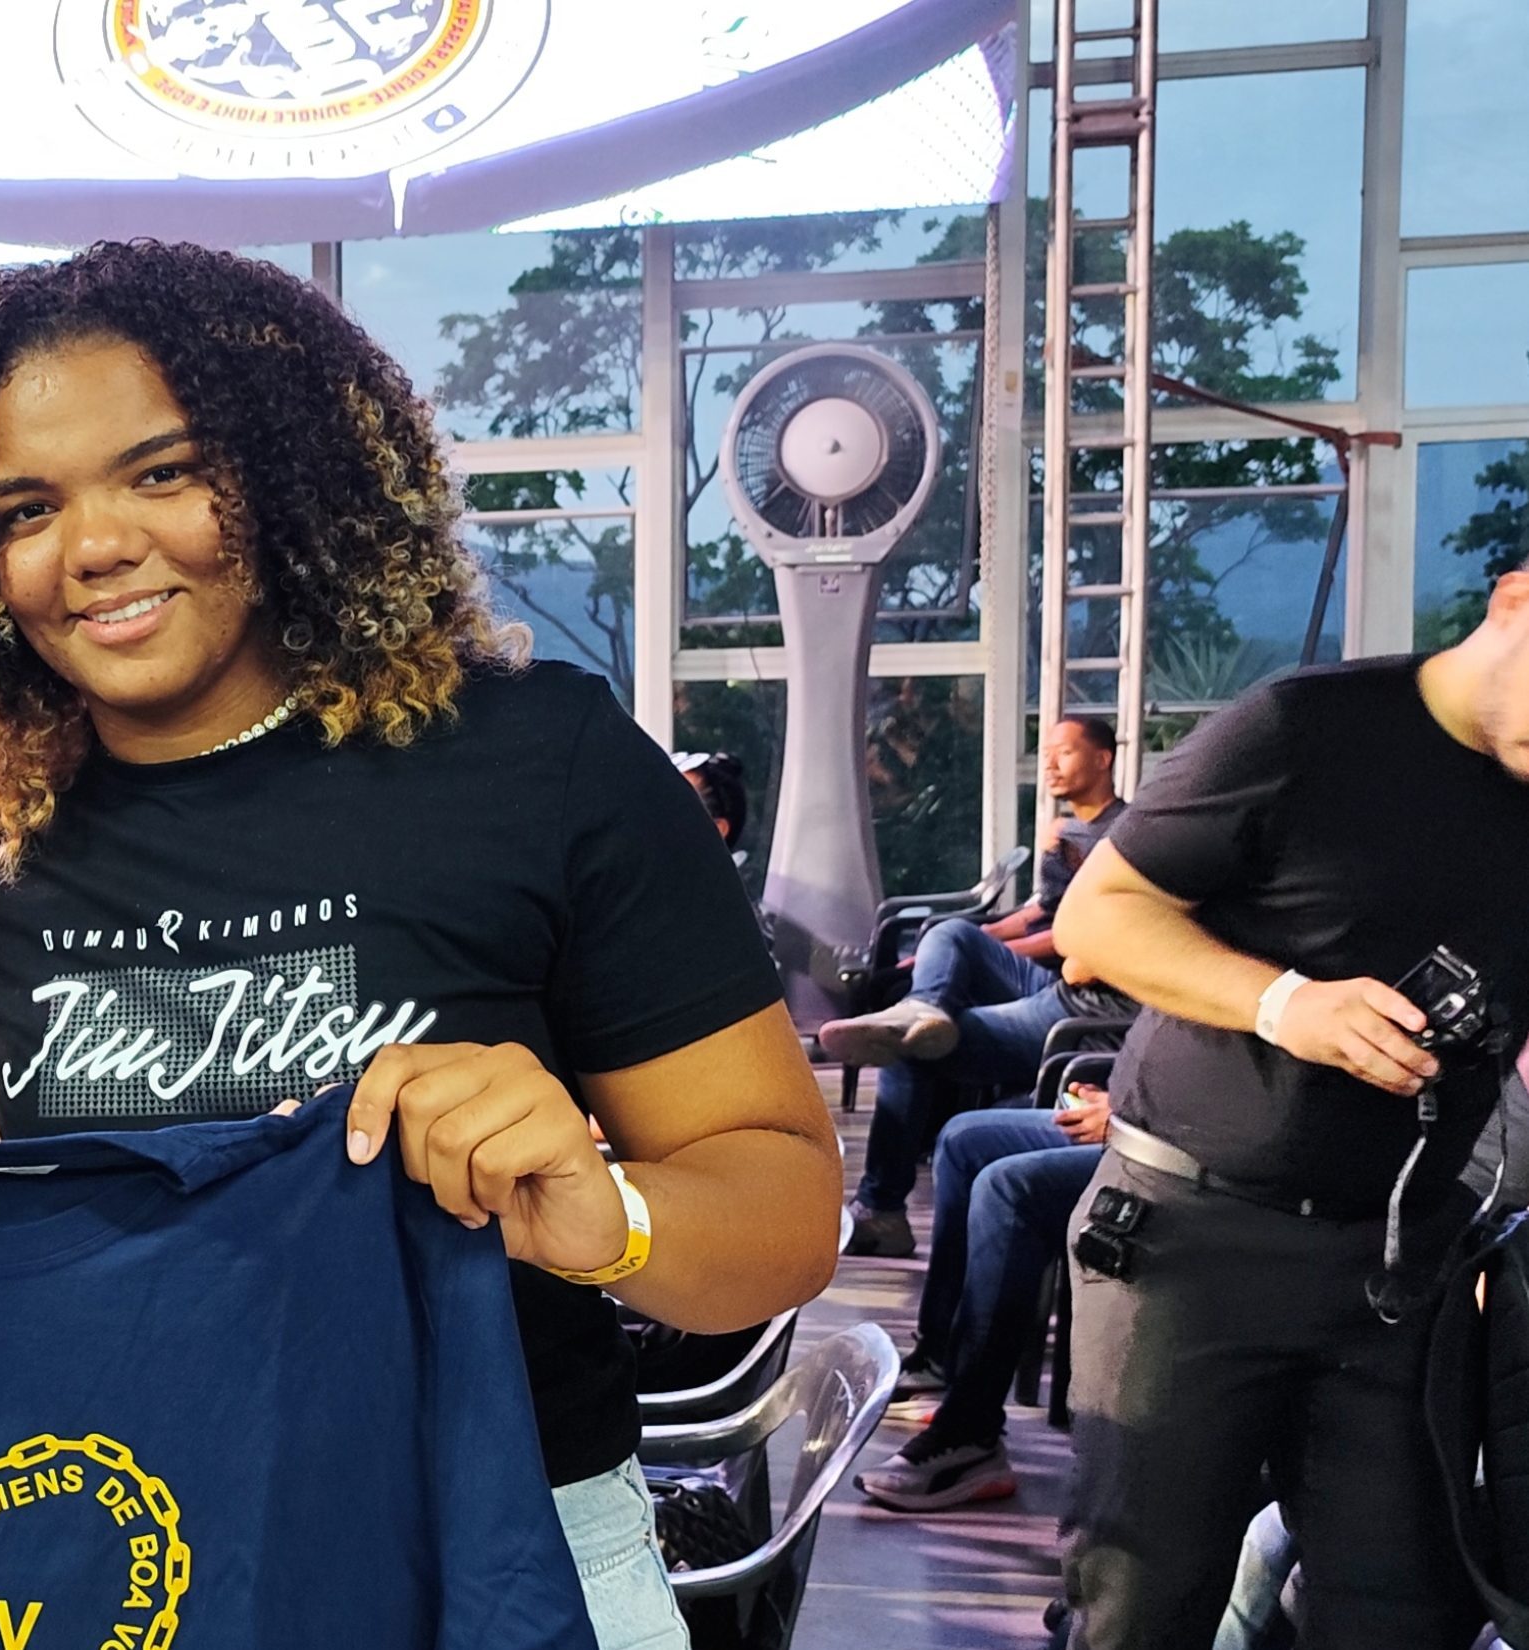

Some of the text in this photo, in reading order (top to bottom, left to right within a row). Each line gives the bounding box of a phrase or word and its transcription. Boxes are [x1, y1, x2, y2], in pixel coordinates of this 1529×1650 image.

[198, 893, 358, 941] KIMONOS
[3, 966, 437, 1098] Jiu Jitsu
[95, 1476, 144, 1527] DE
[122, 1533, 159, 1608] BOA
